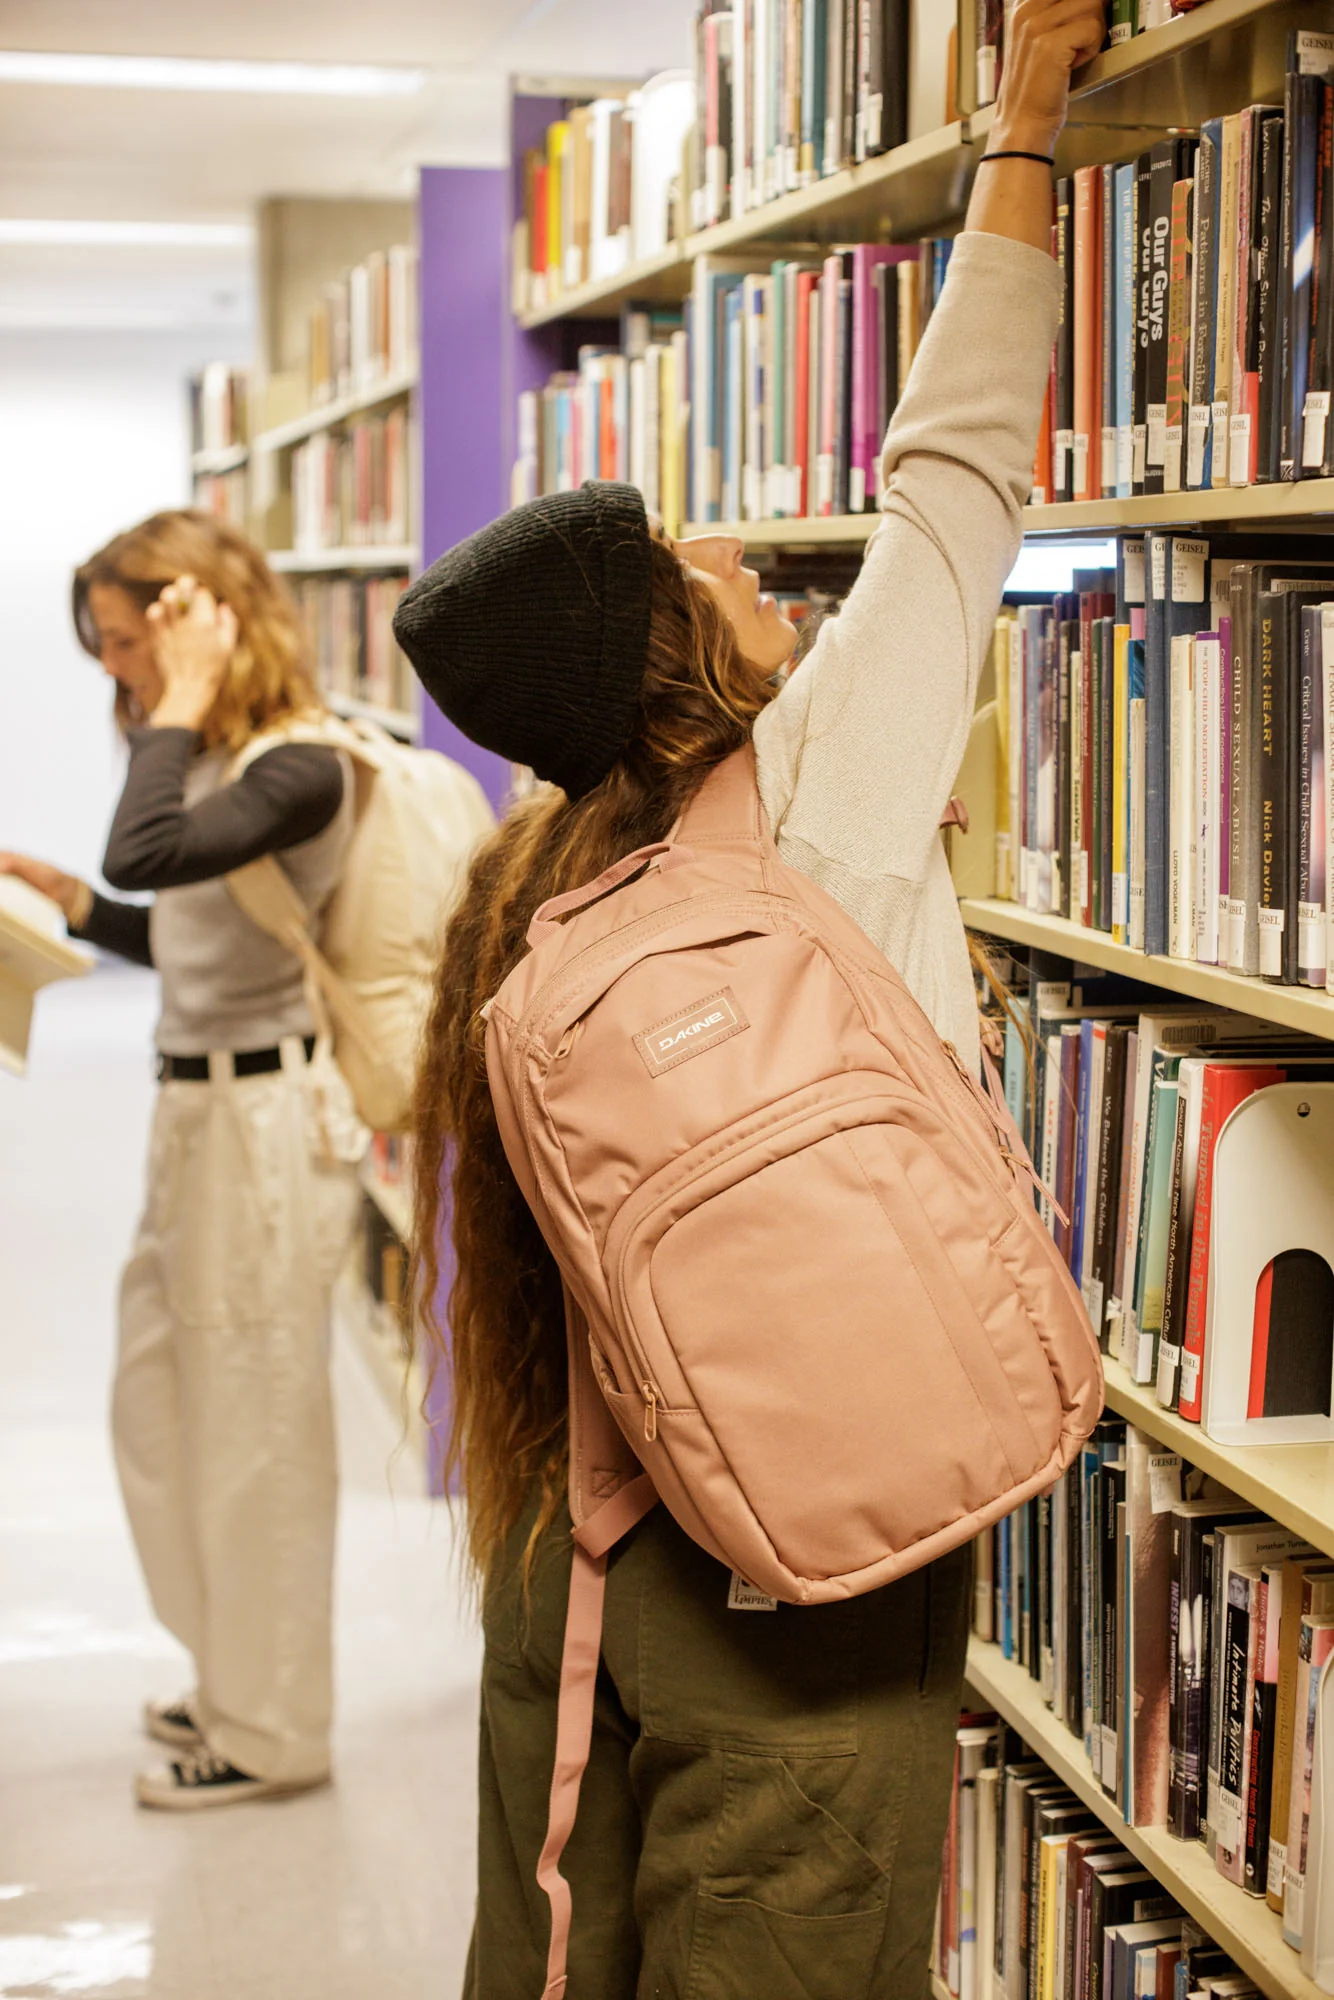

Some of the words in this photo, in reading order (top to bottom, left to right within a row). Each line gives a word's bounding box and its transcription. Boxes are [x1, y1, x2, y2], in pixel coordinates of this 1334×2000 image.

[1262, 127, 1270, 174] Wilson
[1261, 197, 1272, 224] The
[1153, 216, 1170, 267] Our
[1198, 216, 1211, 295] Patterns
[1148, 269, 1169, 342] Guys
[1198, 301, 1209, 318] in
[1175, 543, 1206, 554] GEISEL
[1261, 618, 1273, 678] DARK
[1303, 628, 1312, 656] Conte
[1233, 656, 1242, 714] CHILD
[1301, 676, 1312, 720] Critical
[1261, 685, 1273, 757] HEART
[1232, 722, 1241, 797] SEXUAL
[1300, 723, 1312, 764] Issues
[1300, 767, 1311, 779] in
[1300, 782, 1311, 816] Child
[1231, 804, 1241, 867] ABUSE
[1262, 800, 1273, 844] Nick
[1299, 820, 1310, 864] Sexual
[1172, 878, 1180, 925] VOGELMAN
[1299, 867, 1309, 902] Abus
[658, 1010, 725, 1052] DAKINE
[1106, 1045, 1114, 1073] BECK
[1105, 1095, 1113, 1116] We
[1178, 1099, 1186, 1137] Sexual
[1045, 1142, 1053, 1184] PETER
[1102, 1119, 1112, 1167] Believe
[1174, 1139, 1184, 1176] Abuse
[1198, 1121, 1214, 1207] Tempest
[1101, 1168, 1110, 1189] the
[1173, 1177, 1181, 1188] in
[1097, 1193, 1108, 1246] Children
[1171, 1190, 1180, 1217] Nine
[1196, 1211, 1208, 1232] in
[1169, 1218, 1179, 1250] North
[1194, 1237, 1207, 1270] the
[1165, 1252, 1176, 1306] American
[1162, 1309, 1173, 1342] Cultur
[1186, 1274, 1205, 1347] Temple
[1151, 1457, 1179, 1468] GEISEL
[1256, 1543, 1285, 1553] Jonathan
[1287, 1540, 1309, 1549] Turne
[1170, 1580, 1180, 1634] INCEST
[1229, 1642, 1246, 1711] Intimate
[1227, 1716, 1243, 1786] Politics
[1250, 1729, 1261, 1786] Constructing
[1249, 1787, 1258, 1815] Incest
[1246, 1816, 1257, 1848] Stories
